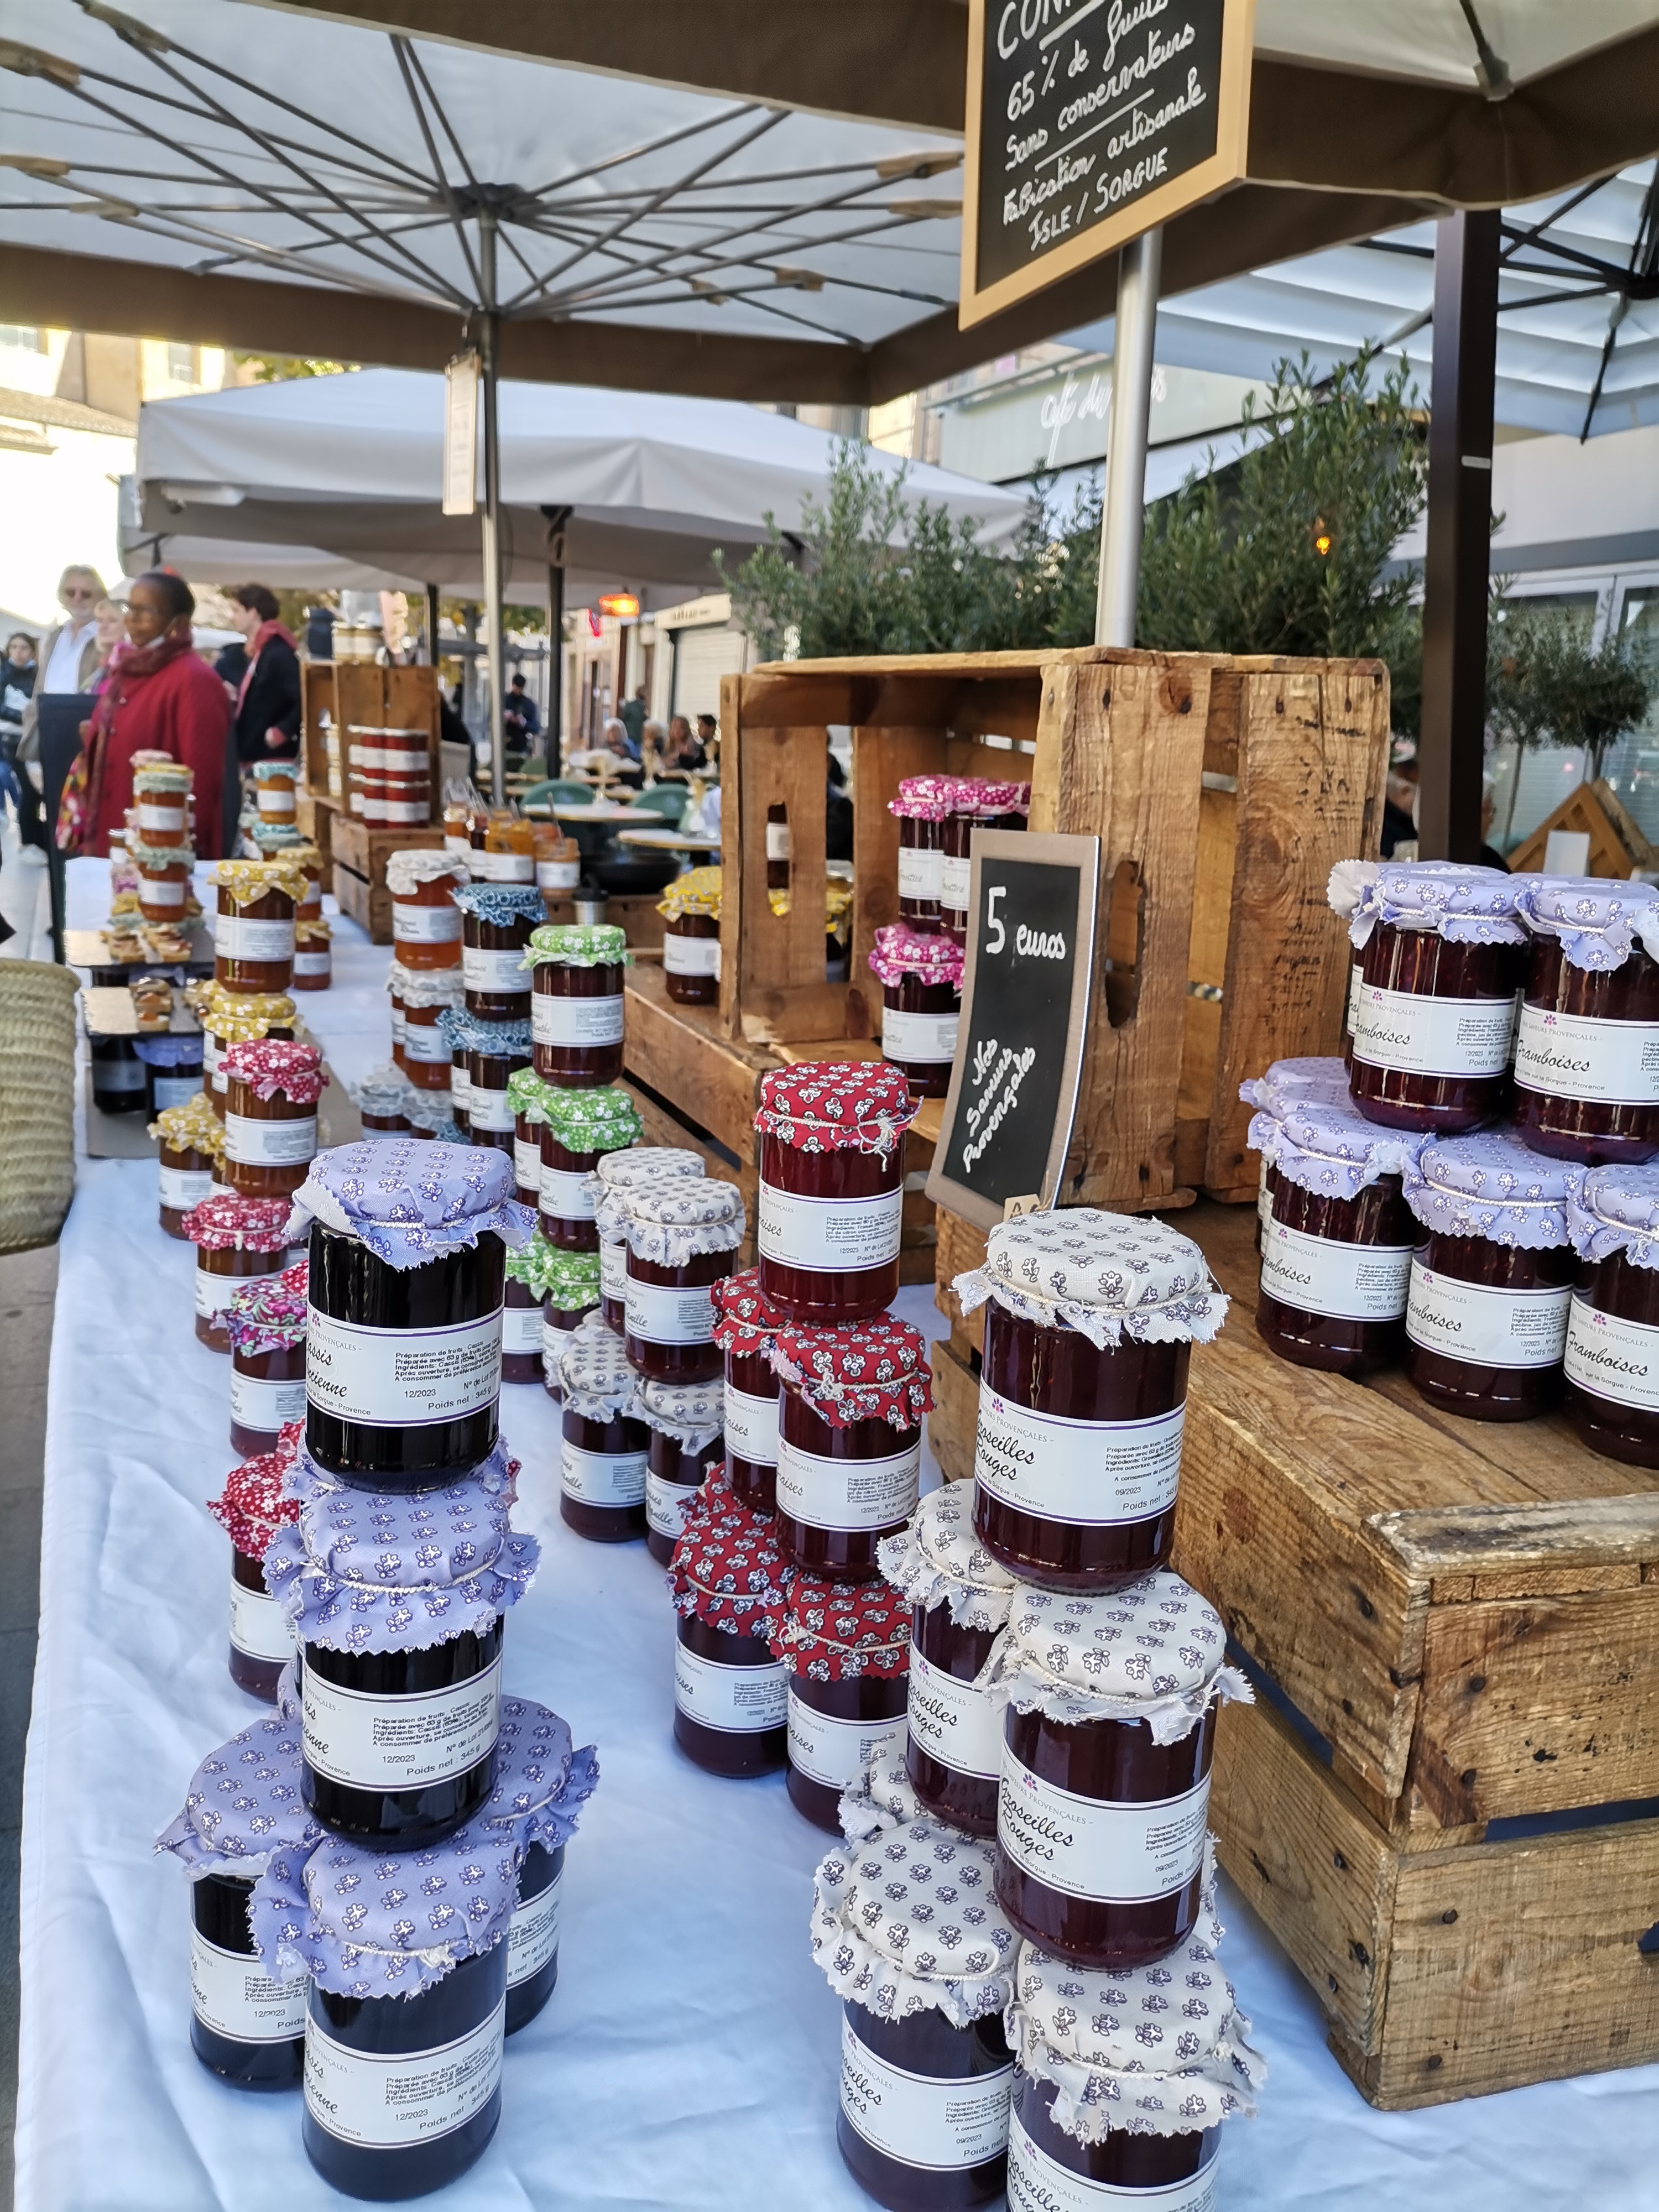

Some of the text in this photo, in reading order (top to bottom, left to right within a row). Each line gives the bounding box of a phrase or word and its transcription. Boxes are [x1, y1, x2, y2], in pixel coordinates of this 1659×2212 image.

[1068, 39, 1089, 77] de
[1005, 23, 1196, 171] Sans conservateurs
[1107, 66, 1207, 159] artisanale
[1029, 205, 1072, 252] ISLE
[1094, 147, 1168, 214] SORGUE
[985, 885, 1066, 960] 5 euros
[1355, 1022, 1411, 1045] ramboises
[1549, 1029, 1597, 1041] PROVENÇALES
[971, 1038, 998, 1086] Nos
[1517, 1039, 1590, 1072] Framboises
[1546, 1077, 1605, 1091] Sorgue Provence
[315, 1330, 356, 1352] PROVENÇALES
[1447, 1339, 1476, 1352] Provence
[1598, 1329, 1648, 1347] PROVENÇALES
[1567, 1331, 1649, 1376] Framboises
[404, 1389, 436, 1398] 12/2023
[463, 1380, 472, 1390] N°
[1601, 1376, 1624, 1389] Sorgue
[316, 1392, 371, 1415] Sorgue Provence
[428, 1400, 454, 1410] Poids
[457, 1396, 469, 1405] net
[476, 1389, 487, 1399] 345
[997, 1415, 1047, 1443] PROVENÇALES
[1121, 1472, 1152, 1481] consommer
[1014, 1493, 1045, 1507] Provence
[1115, 1486, 1141, 1496] 09/2023
[1123, 1501, 1147, 1511] Poids
[1150, 1495, 1161, 1505] net
[921, 1677, 967, 1707] PROVENÇALES
[911, 1704, 943, 1739] ouges
[382, 1754, 416, 1763] 12/2023
[458, 1740, 467, 1748] de
[406, 1766, 436, 1776] Poids
[438, 1758, 453, 1770] net
[461, 1747, 475, 1761] 345
[940, 1749, 968, 1766] Provence
[321, 1759, 350, 1776] Provence
[1001, 1777, 1074, 1847] Groseilles
[1029, 1793, 1087, 1825] PROVENÇALES
[1001, 1799, 1055, 1861] Rouges
[1155, 1859, 1178, 1872] 09/2023
[1051, 1872, 1085, 1890] Provence
[1161, 1871, 1183, 1886] Poids
[277, 2017, 305, 2029] Poids
[387, 2074, 429, 2084] Préparation
[395, 2109, 429, 2121] 12/2023
[419, 2116, 448, 2130] Poids
[450, 2105, 465, 2119] net
[329, 2117, 361, 2136] Provence
[956, 2134, 982, 2145] 09/2023
[963, 2145, 989, 2158] Poids
[1029, 2159, 1082, 2204] PROVENÇALES
